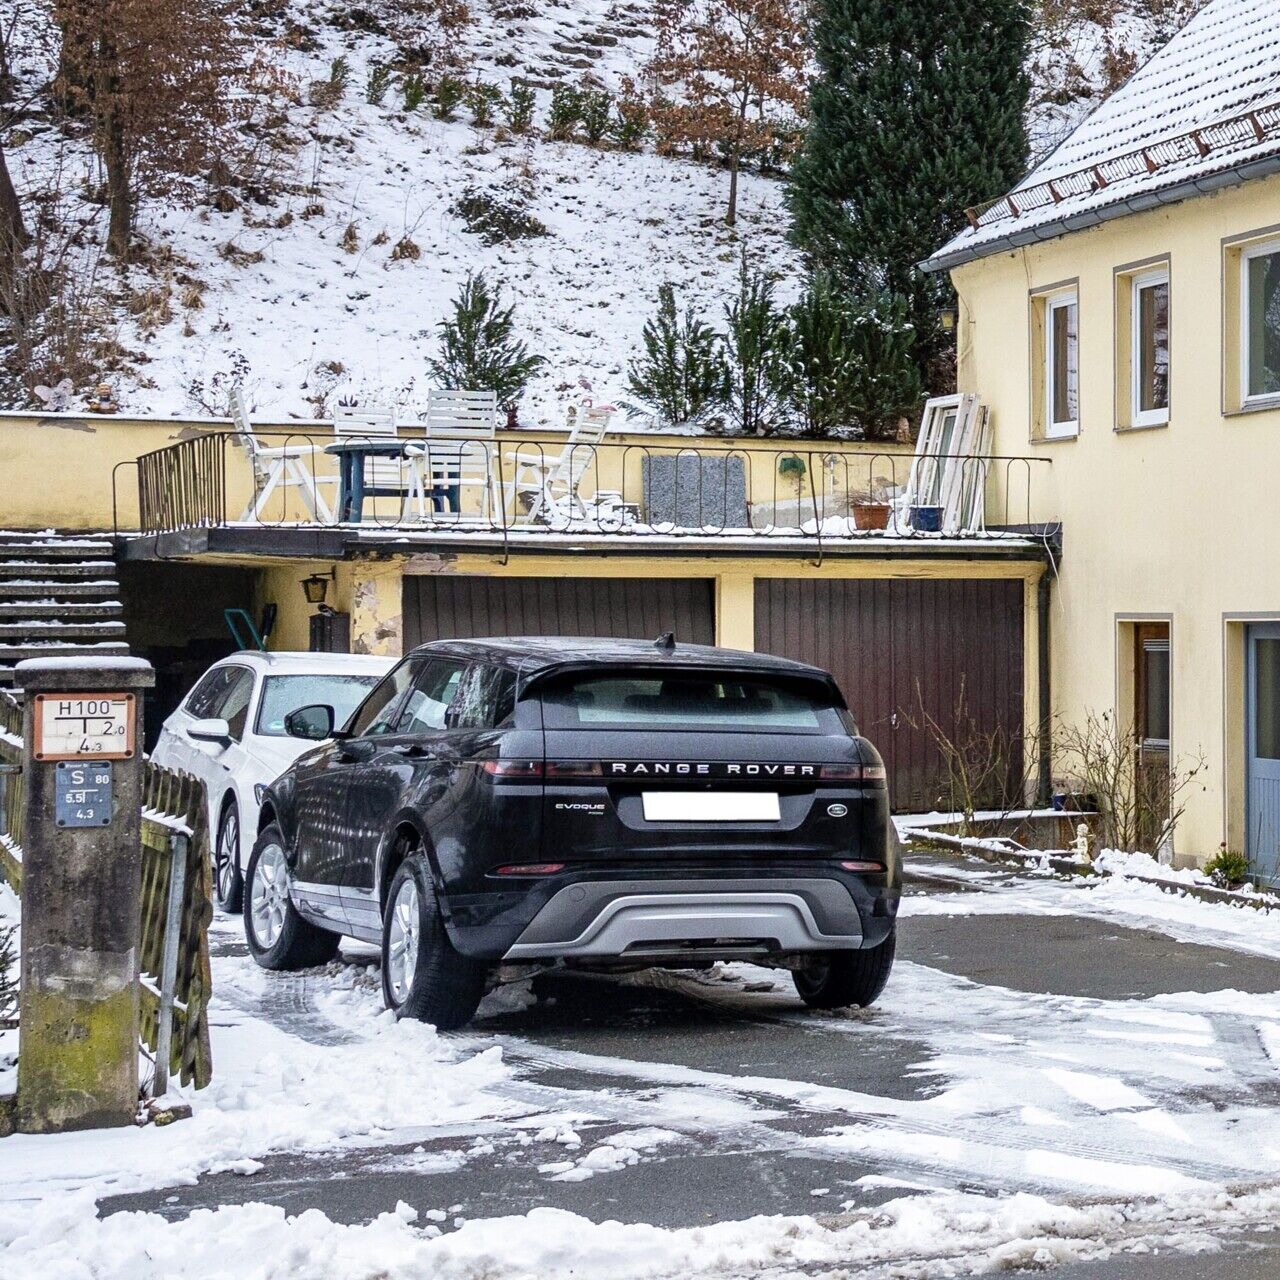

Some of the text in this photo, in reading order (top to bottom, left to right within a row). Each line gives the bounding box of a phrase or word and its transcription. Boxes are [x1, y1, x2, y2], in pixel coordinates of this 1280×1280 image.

[611, 763, 815, 776] RANGE ROVER
[71, 770, 110, 785] S 80
